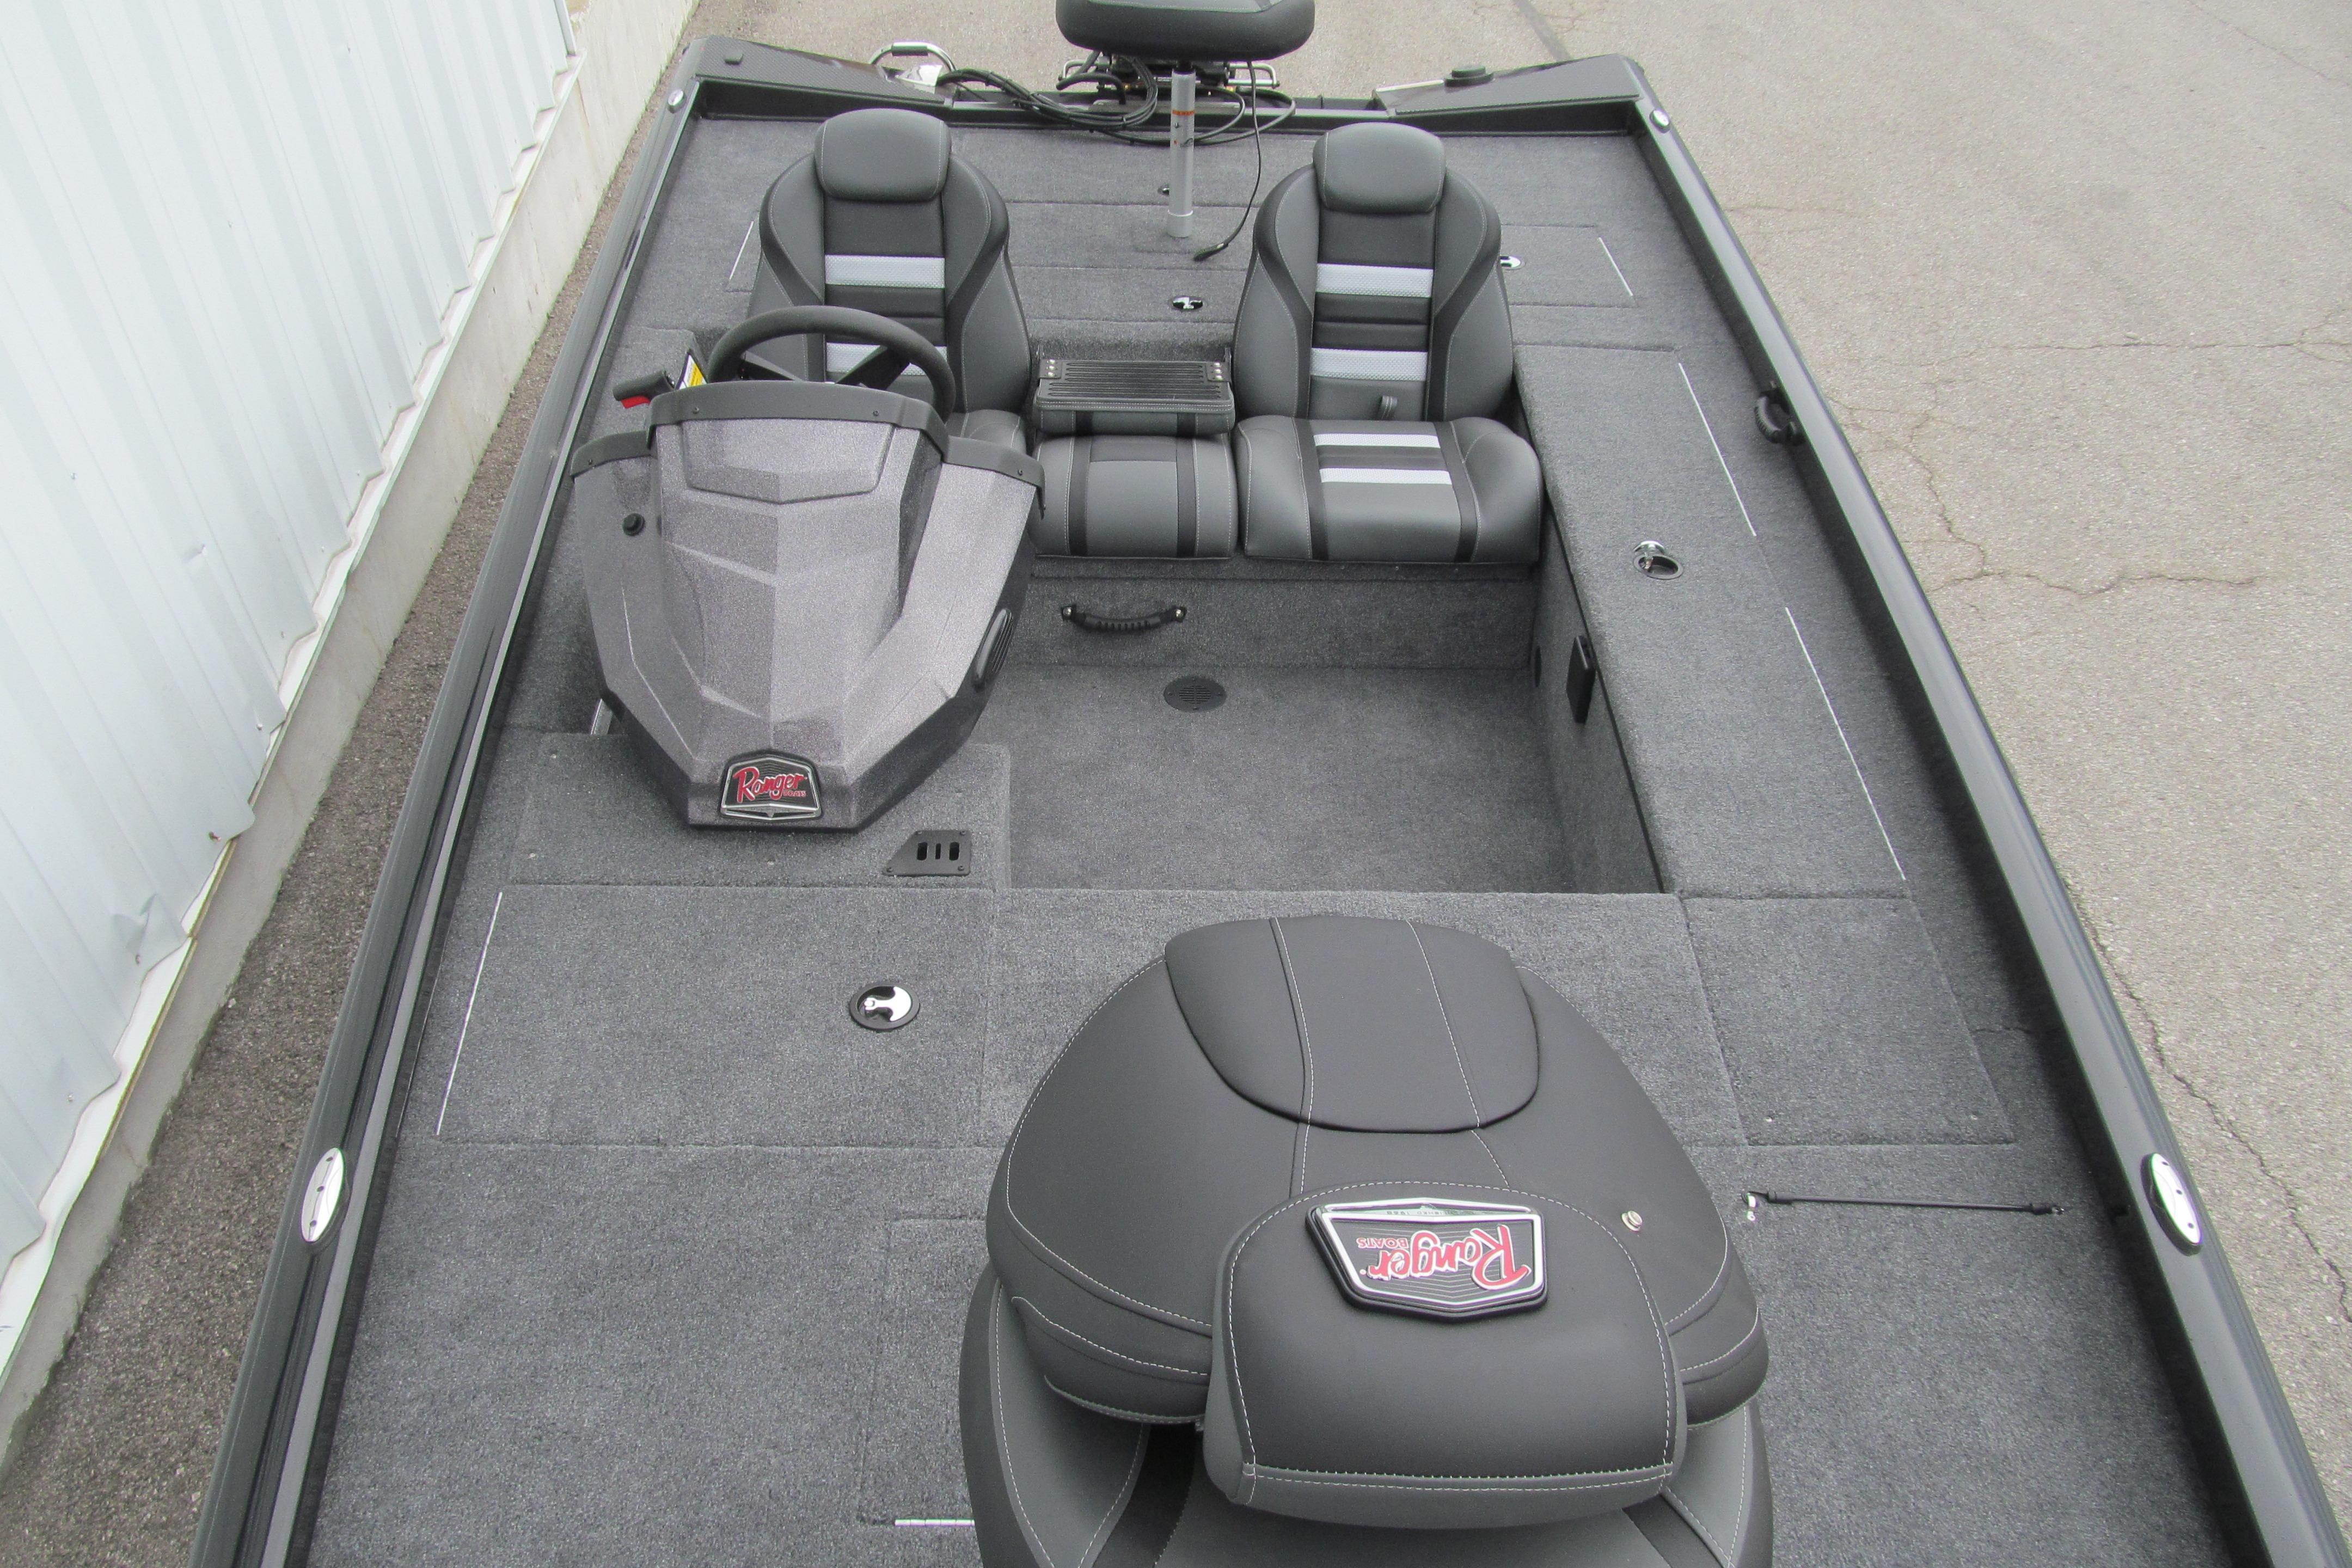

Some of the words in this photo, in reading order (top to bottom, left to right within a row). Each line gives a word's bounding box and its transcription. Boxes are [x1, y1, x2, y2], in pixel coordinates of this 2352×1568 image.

[732, 766, 804, 803] Ranger
[1356, 1237, 1409, 1248] BOATS
[1366, 1224, 1532, 1290] Ranger
